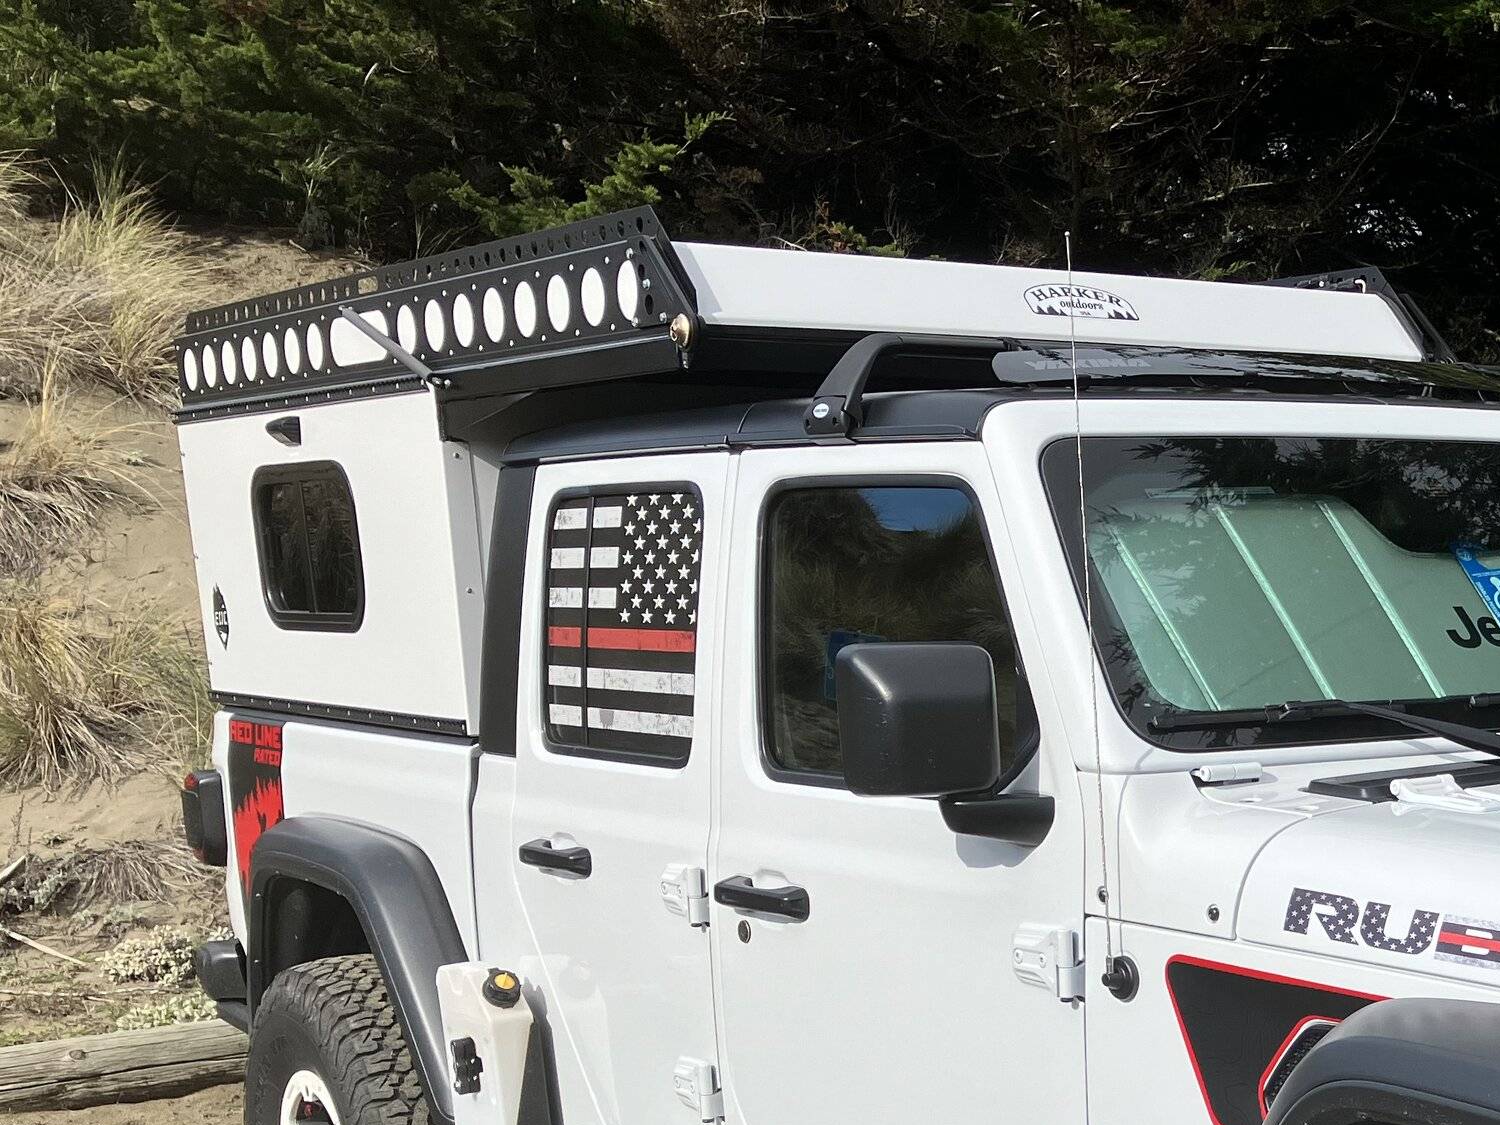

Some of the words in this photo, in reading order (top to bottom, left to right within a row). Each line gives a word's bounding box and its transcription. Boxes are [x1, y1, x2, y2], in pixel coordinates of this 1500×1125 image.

[1030, 287, 1124, 308] HARKER
[1060, 298, 1104, 310] outdoors
[1024, 358, 1152, 371] YAKIMA
